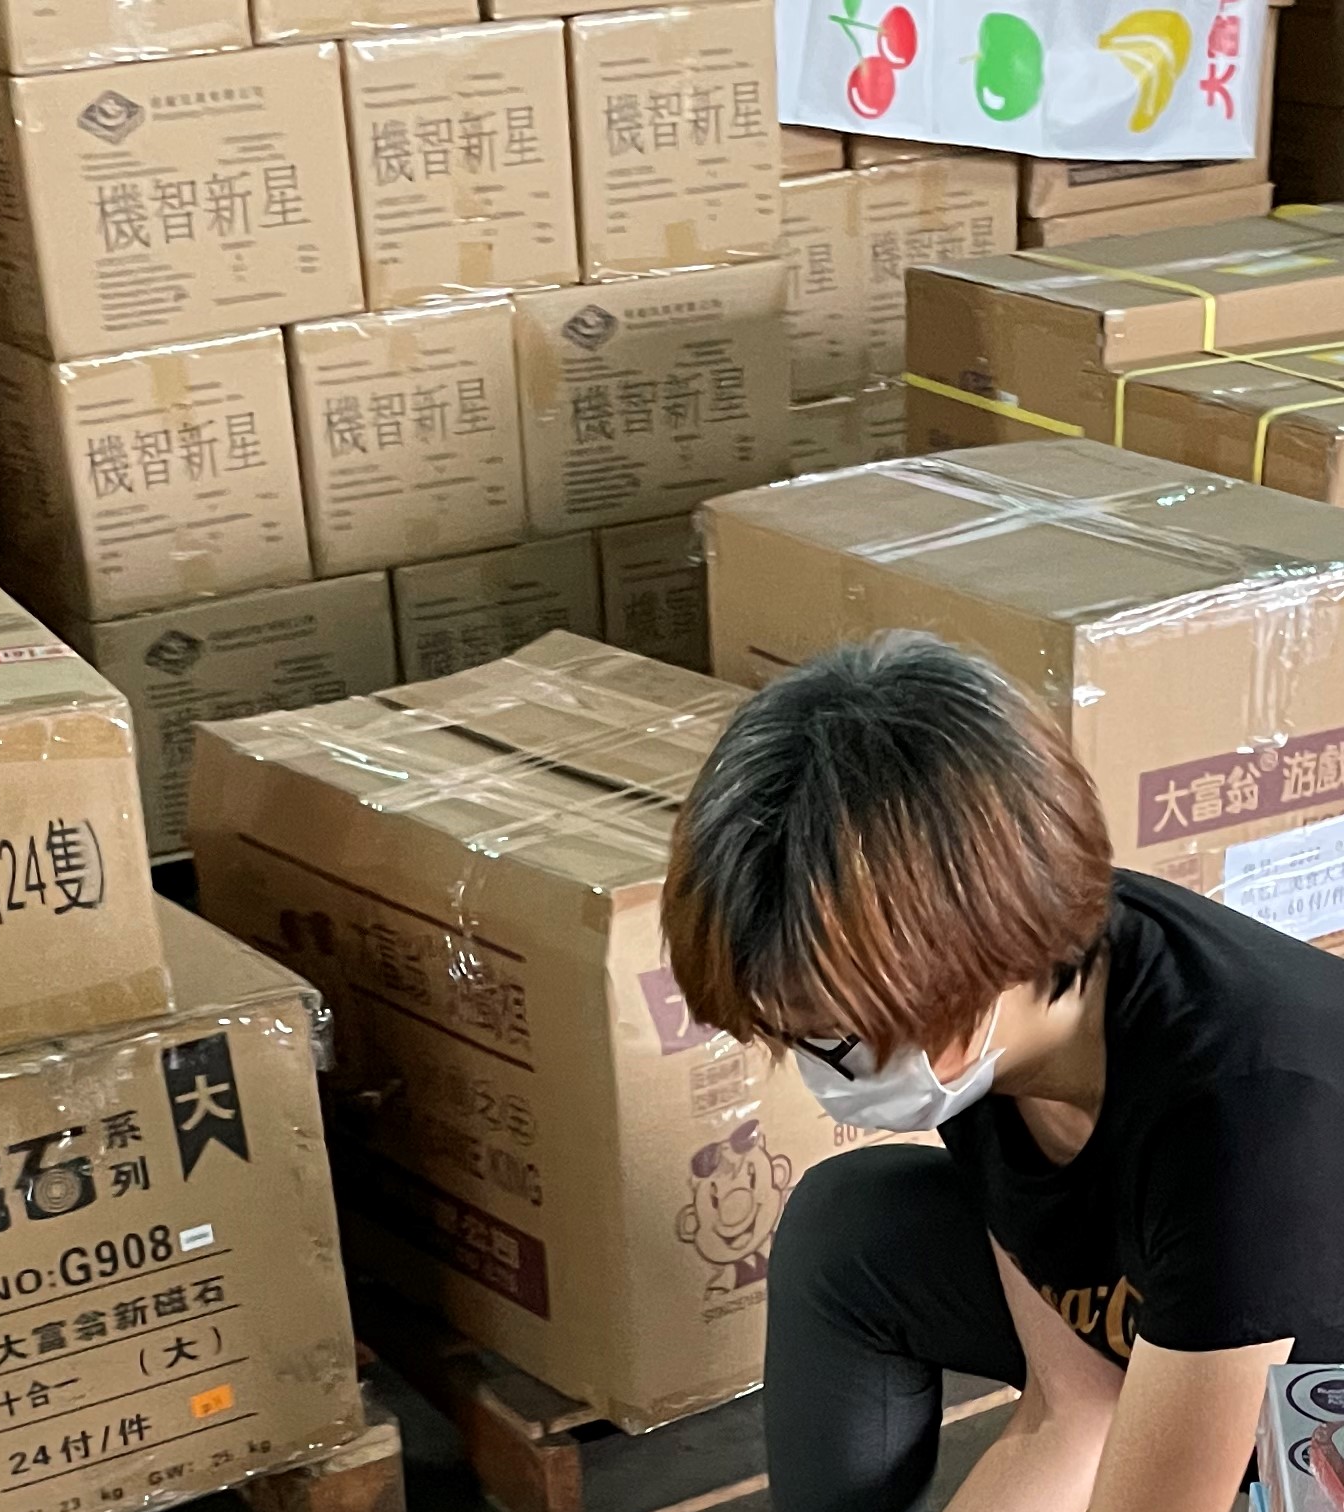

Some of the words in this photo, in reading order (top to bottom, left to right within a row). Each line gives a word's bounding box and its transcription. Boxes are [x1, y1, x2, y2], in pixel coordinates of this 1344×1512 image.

[1199, 0, 1241, 120] 大富
[370, 105, 542, 187] 機智新星
[602, 79, 769, 157] 機智新星
[90, 164, 312, 252] 機智新星
[325, 378, 495, 456] 機智新星
[571, 366, 749, 444] 機智新星
[85, 411, 268, 498] 機智新星
[1154, 762, 1262, 832] 大富翁
[174, 1074, 236, 1131] 大
[100, 1109, 152, 1199] 系列
[8, 1412, 154, 1477] 24付/件
